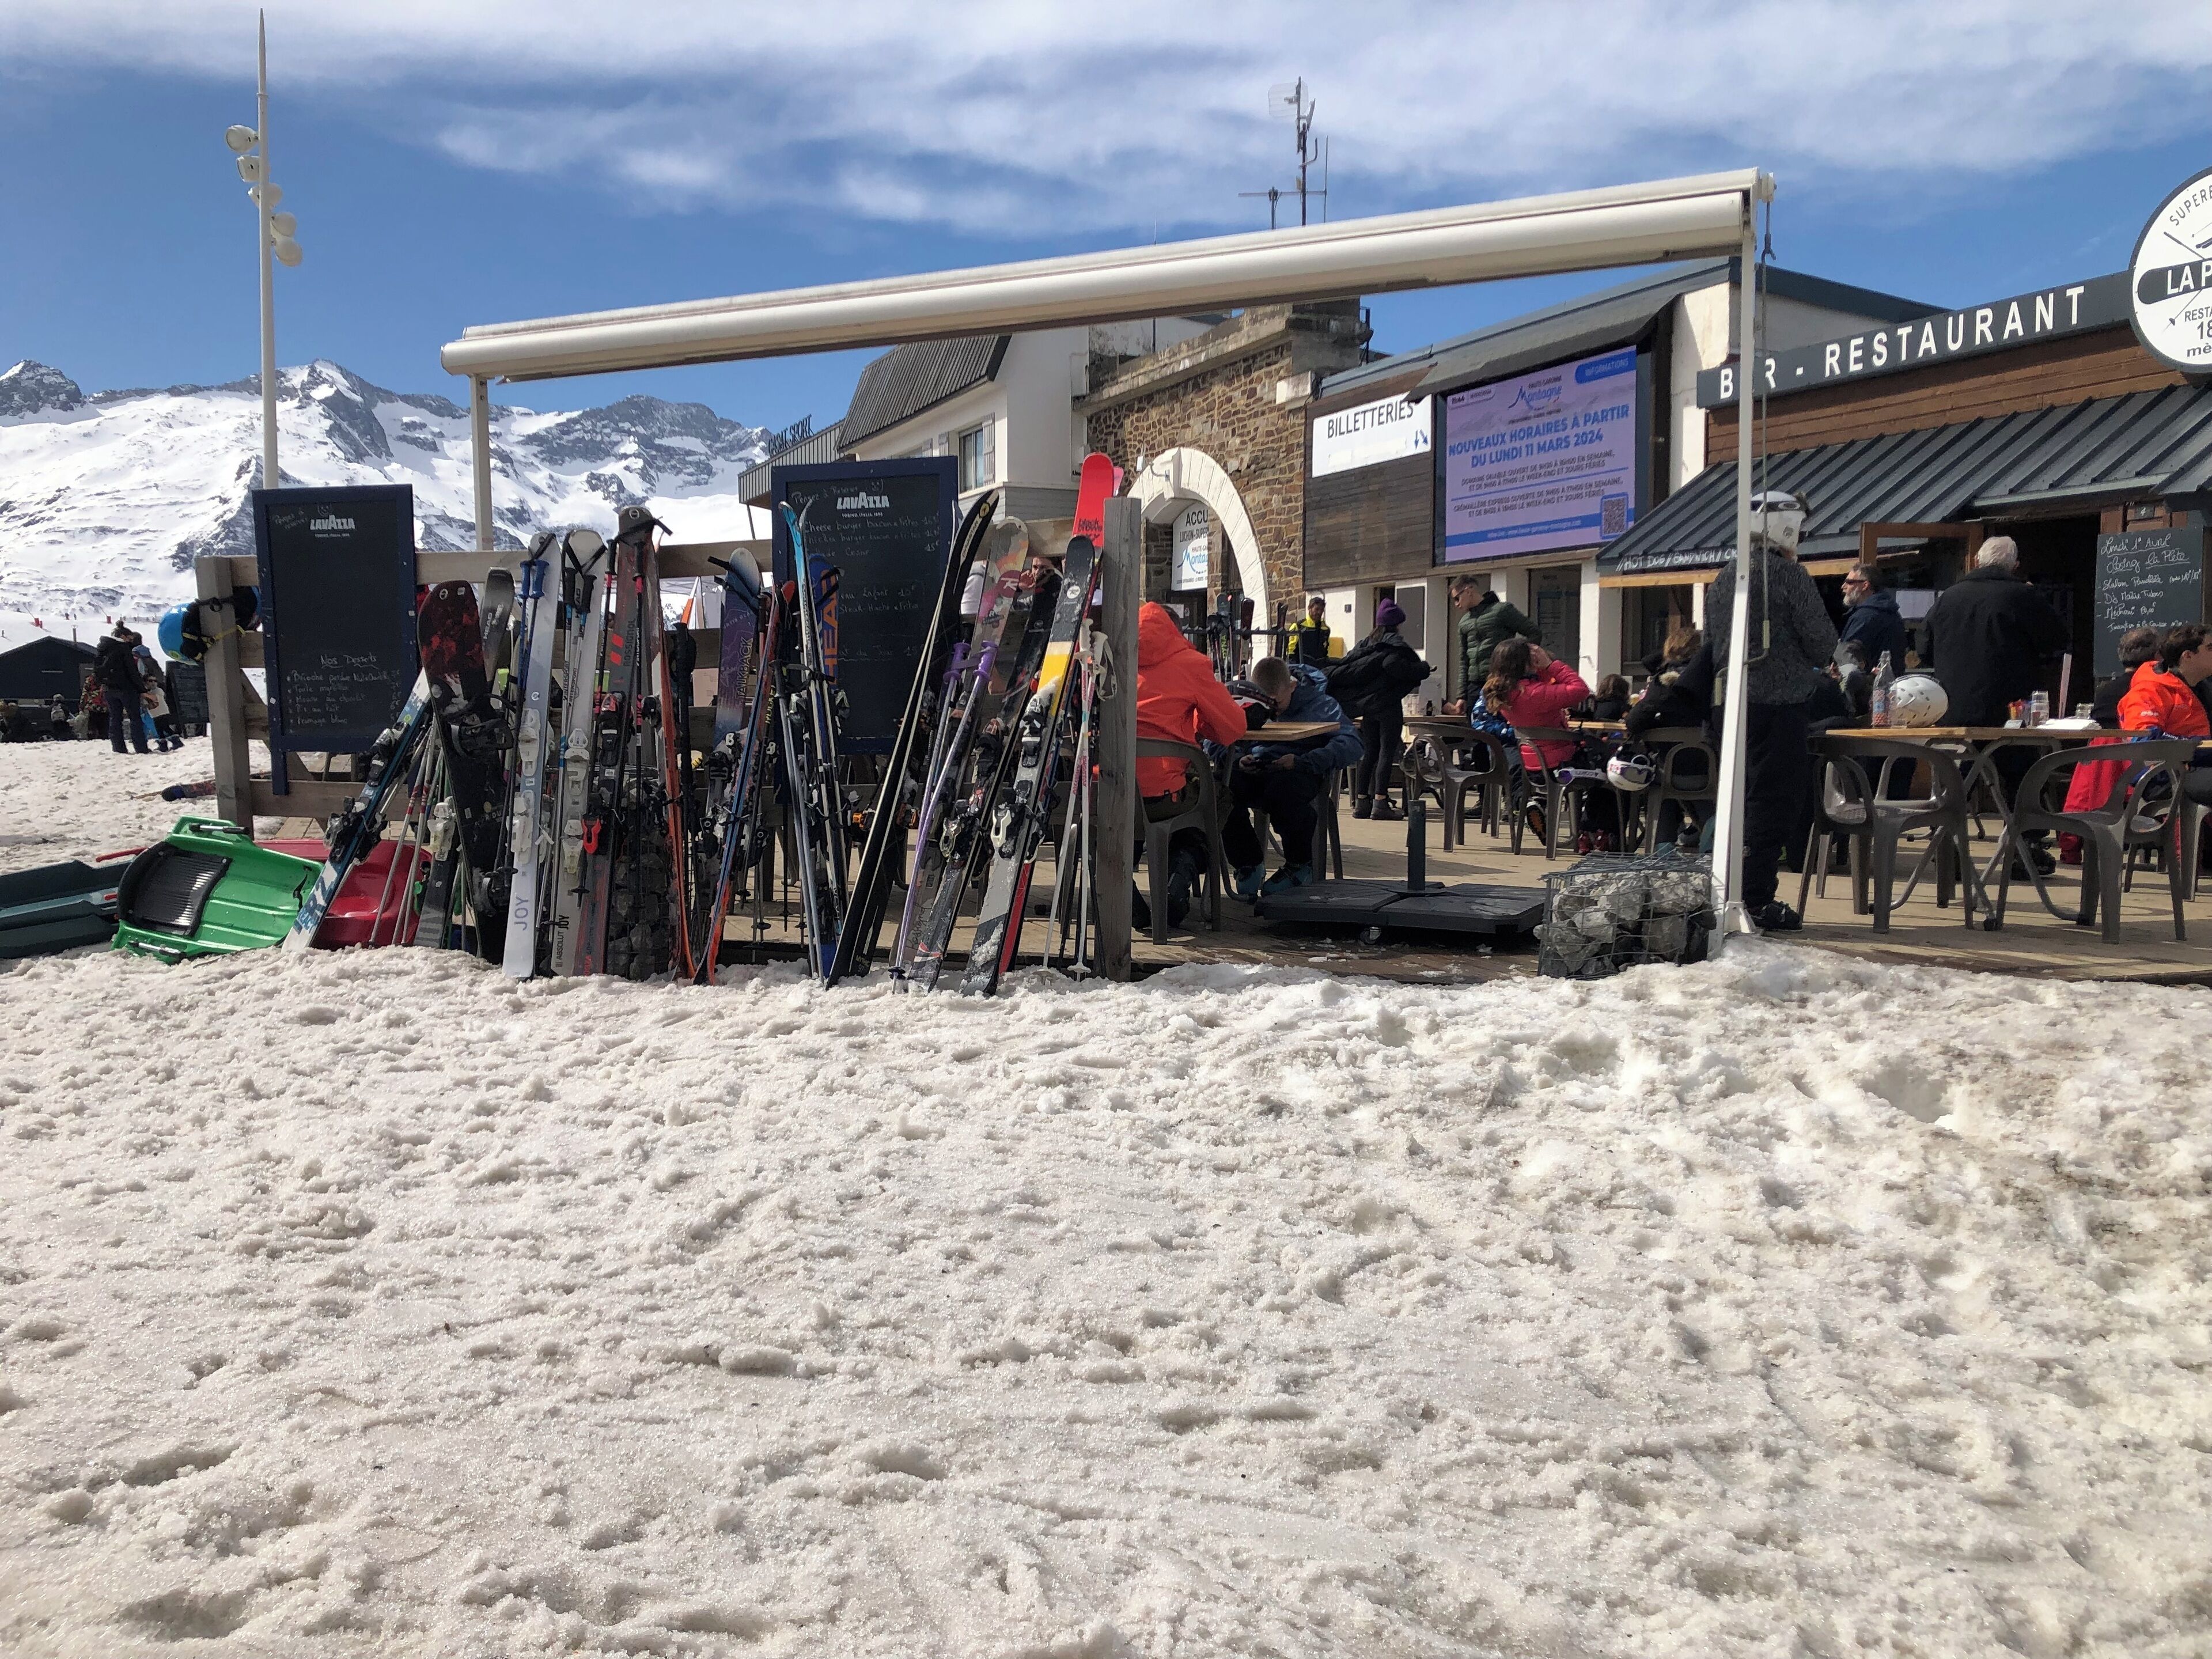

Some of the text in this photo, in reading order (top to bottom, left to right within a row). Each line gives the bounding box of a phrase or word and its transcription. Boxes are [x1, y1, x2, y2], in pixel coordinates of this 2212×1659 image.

[2167, 265, 2195, 296] LA
[1719, 357, 1776, 400] BR
[1824, 285, 2085, 378] RESTAURANT
[1327, 400, 1414, 439] BILLETTERIES
[1449, 435, 1506, 455] NOUVEAUX
[1510, 421, 1568, 441] HORAIRES
[1583, 406, 1629, 425] PARTIR
[1471, 454, 1486, 467] DU
[1490, 448, 1522, 463] LUNDI
[1536, 437, 1570, 453] MARS
[1573, 430, 1603, 446] 2024
[836, 491, 890, 510] LAVAZZA
[1185, 509, 1209, 527] ACCU
[310, 514, 355, 530] LAVAZZA
[514, 896, 528, 931] JOY
